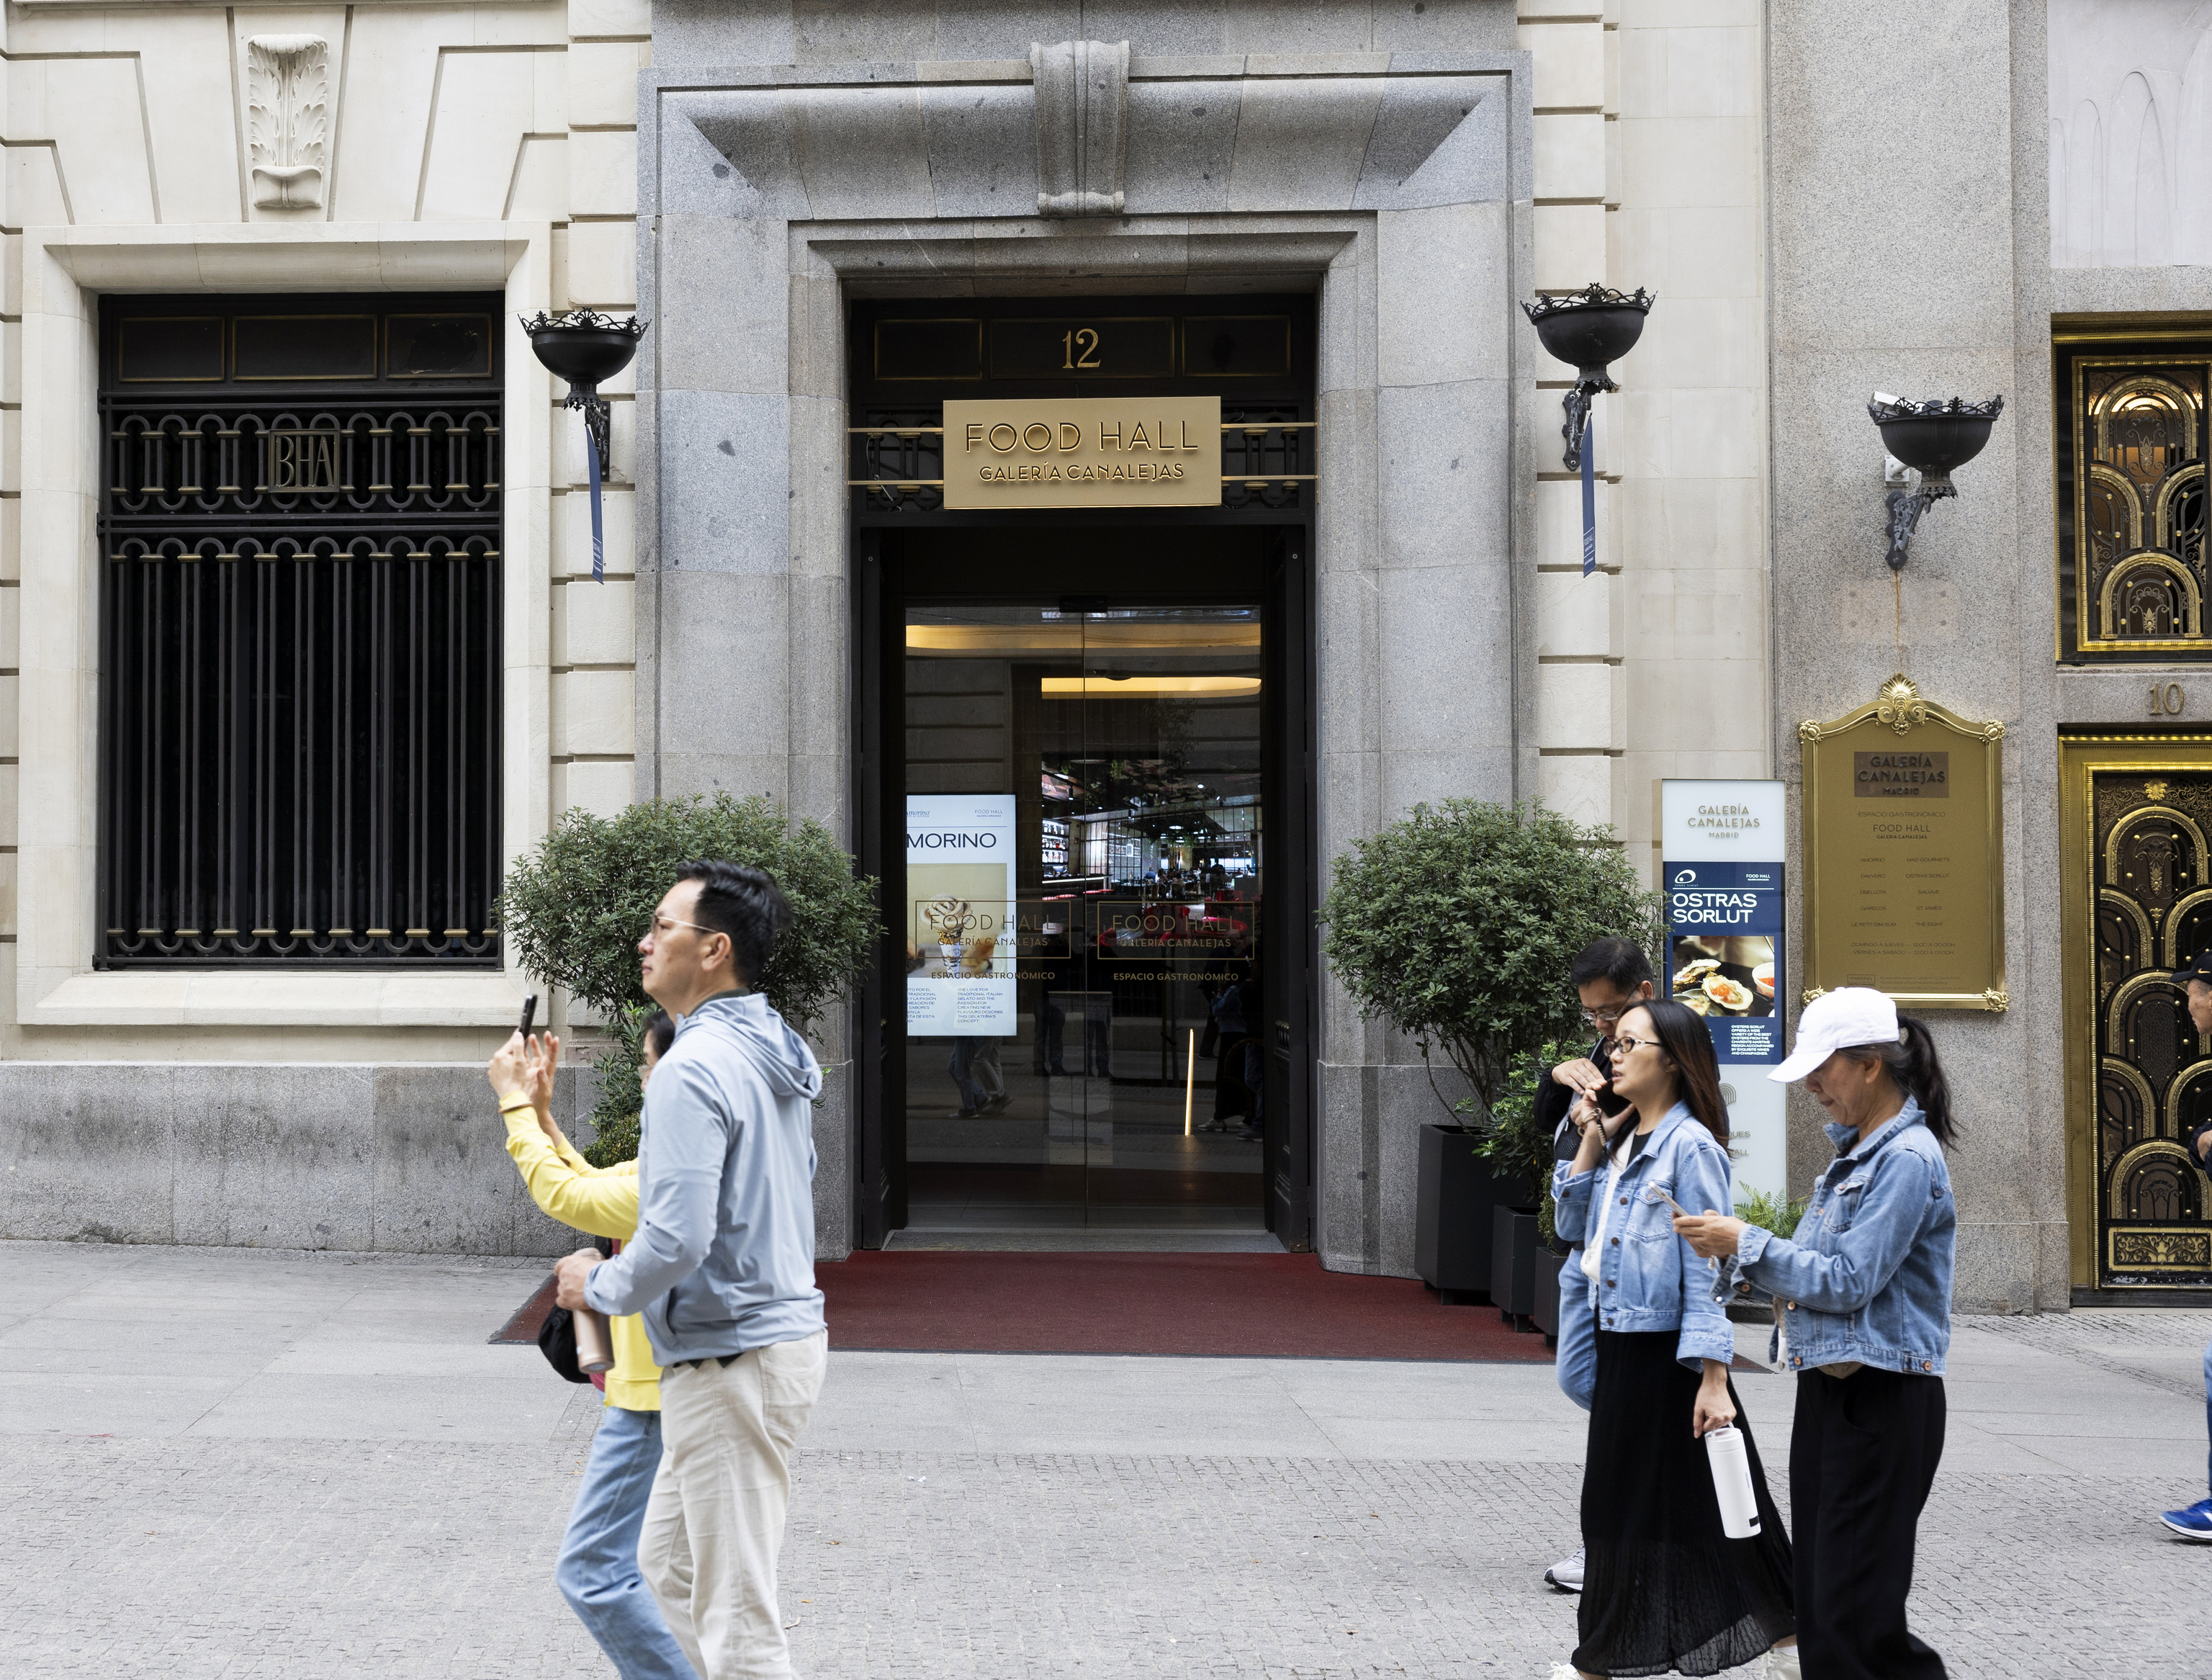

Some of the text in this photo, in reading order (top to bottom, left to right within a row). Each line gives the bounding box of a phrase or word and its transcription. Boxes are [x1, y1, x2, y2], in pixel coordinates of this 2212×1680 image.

[1062, 328, 1101, 368] 12
[966, 421, 1198, 453] FOOD HALL
[275, 435, 334, 487] BHA
[979, 462, 1184, 482] GALERÍA CANALEJAS
[2149, 682, 2185, 715] 10
[1870, 753, 1933, 768] GALERÍA
[1858, 769, 1946, 783] CANALEJAS
[1883, 786, 1920, 795] MADRID
[1698, 803, 1749, 814] GALERÍA
[1688, 817, 1761, 828] CANALEJAS
[1673, 893, 1758, 907] OSTRAS
[930, 915, 1056, 930] FOOD HALL
[1112, 915, 1239, 931] FOOD HALL
[1673, 909, 1753, 924] SORLUT
[938, 935, 1048, 947] GALERÍA CANALEJAS
[1120, 936, 1231, 948] GALERÍA CANALEJAS
[974, 970, 1055, 979] GASTRONÓMICO
[1156, 971, 1239, 981] GASTRONÓMICO
